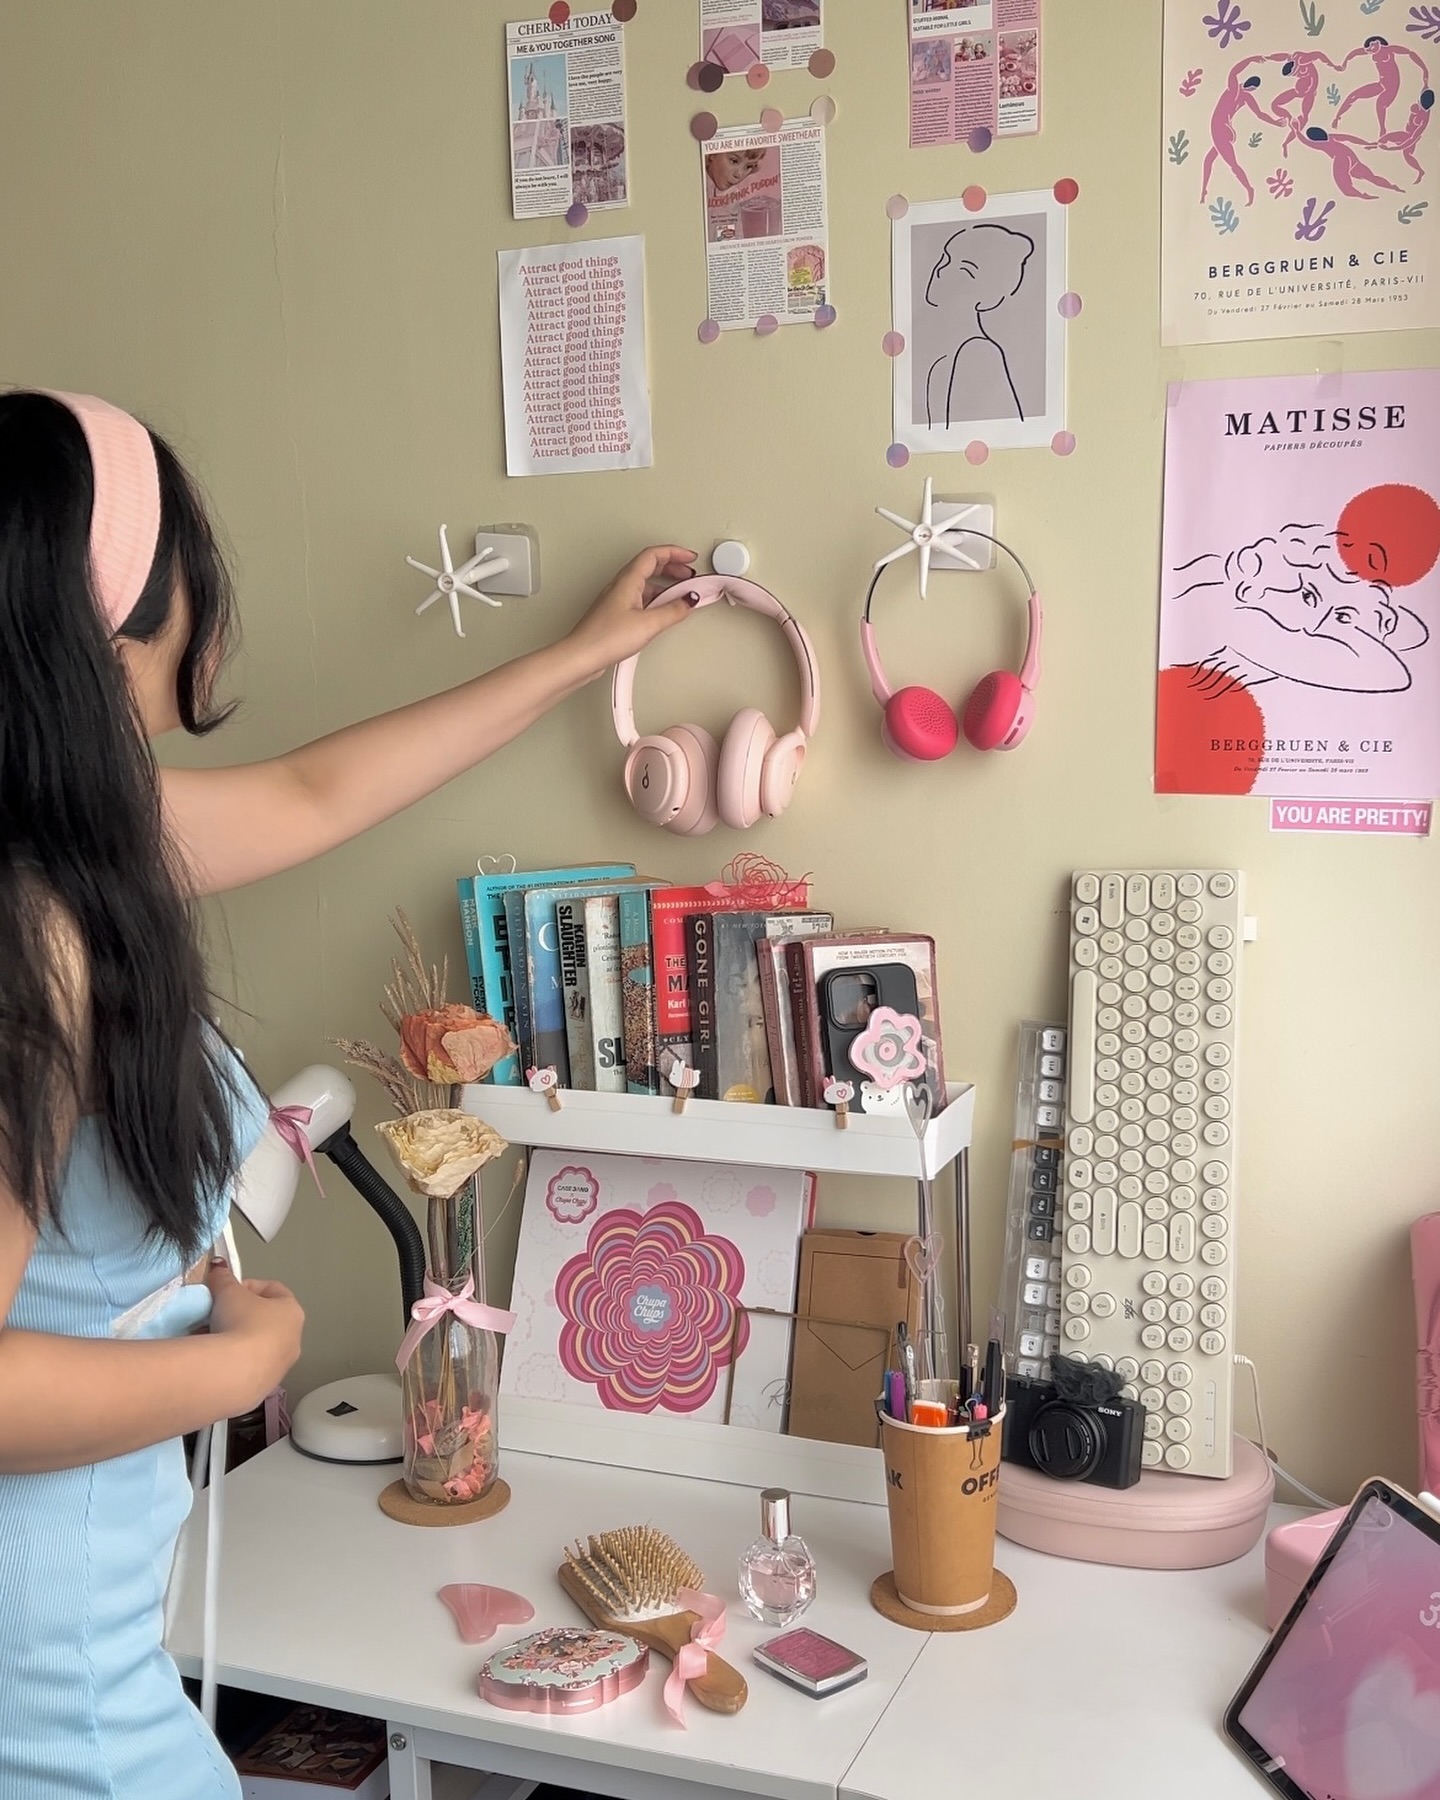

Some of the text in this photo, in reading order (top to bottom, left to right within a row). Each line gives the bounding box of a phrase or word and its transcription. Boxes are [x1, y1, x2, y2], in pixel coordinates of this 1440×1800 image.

[518, 13, 613, 36] CHERISH TODAY
[517, 33, 615, 54] ME & YOU TOGETHER SONG
[999, 101, 1024, 109] Luminous
[704, 129, 821, 151] YOU ARE MY FAVORITE SWEETHEART
[519, 256, 619, 275] Attract good things
[1209, 250, 1409, 278] BERGGRUEN & CIE
[522, 267, 621, 286] Attract good things
[525, 279, 624, 298] Attract good things
[1193, 274, 1424, 300] 70, RUE DE L'UNIVERSITÉ, PARIS-VII
[527, 290, 626, 309] Attract good things
[1221, 305, 1257, 315] Vendredi
[1261, 304, 1269, 312] 27
[1319, 299, 1348, 308] Samedi
[1365, 296, 1385, 304] Mars
[1389, 294, 1408, 302] 1953
[528, 302, 626, 321] Attract good things
[528, 314, 626, 332] Attract good things
[527, 325, 624, 344] Attract good things
[525, 337, 622, 356] Attract good things
[524, 349, 621, 367] Attract good things
[523, 361, 620, 379] Attract good things
[523, 372, 620, 390] Attract good things
[523, 384, 620, 402] Attract good things
[525, 395, 621, 413] Attract good things
[527, 407, 624, 424] Attract good things
[1224, 405, 1406, 436] MATISSE
[529, 418, 627, 436] Attract good things
[530, 430, 629, 447] Attract good things
[1264, 439, 1363, 452] PAPIERS DÉCOUPÉS
[533, 441, 631, 459] Attract good things
[1210, 739, 1393, 753] BERGGRUEN & CIE
[1276, 806, 1428, 827] YOU ARE PRETTY!
[462, 899, 474, 946] MANSON
[469, 898, 478, 929] MARK
[559, 905, 577, 987] SLAUGHTER
[574, 924, 586, 968] KARIN
[666, 957, 686, 968] THE
[517, 946, 529, 1029] MOUNTAIN
[695, 920, 710, 1053] GONE GIRL
[667, 1000, 686, 1009] Karl
[637, 1295, 667, 1309] Chupa
[634, 1305, 664, 1324] Chups
[1098, 1406, 1122, 1417] SONY
